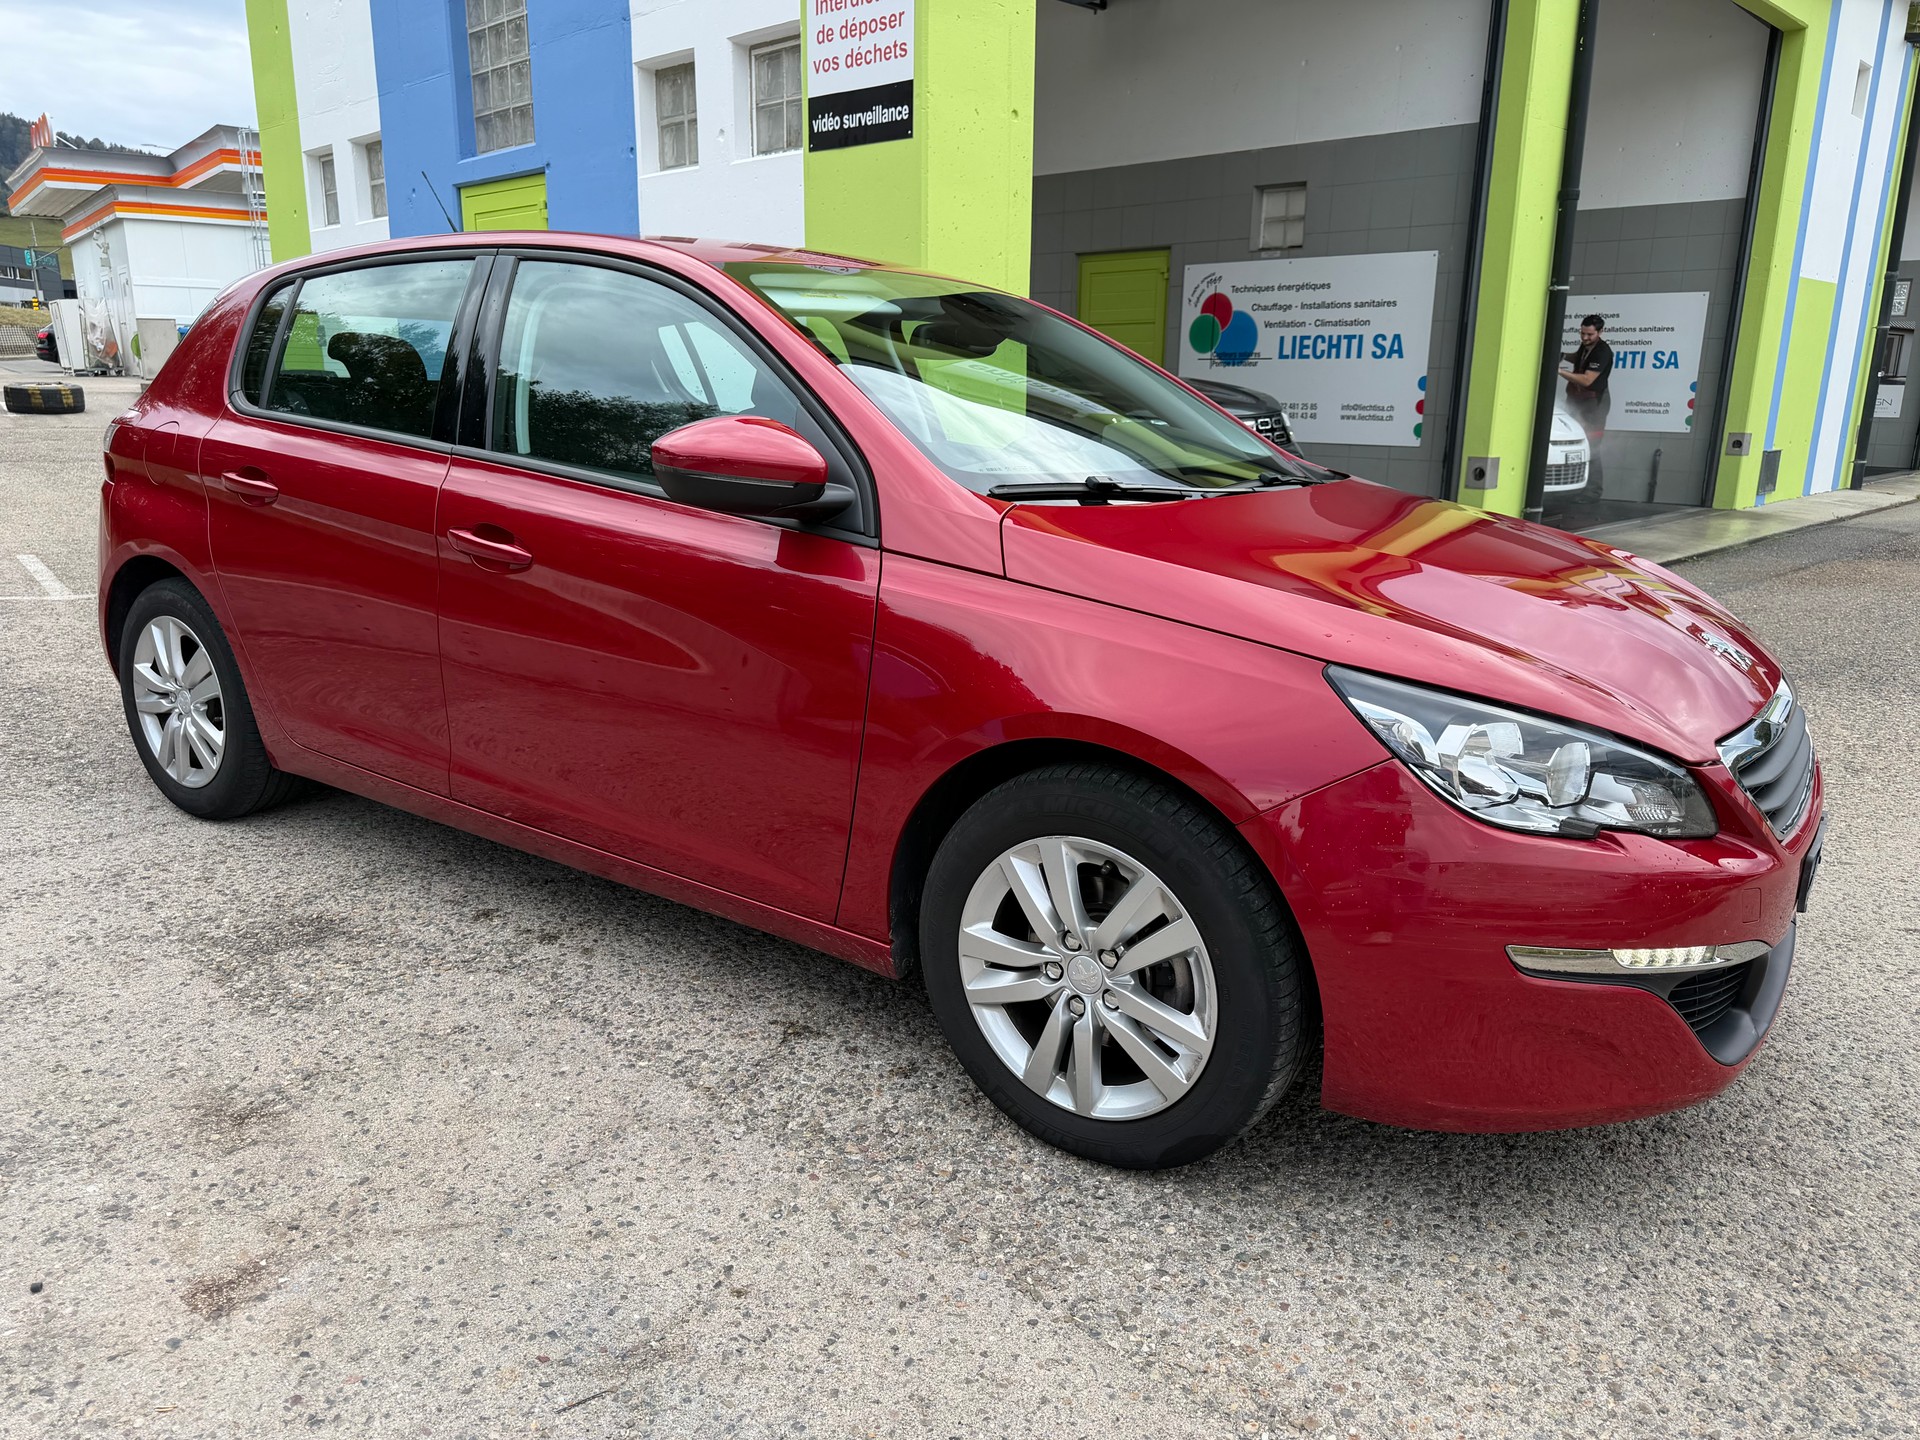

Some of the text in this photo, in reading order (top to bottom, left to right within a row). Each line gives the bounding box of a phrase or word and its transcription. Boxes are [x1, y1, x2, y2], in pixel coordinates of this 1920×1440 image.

[816, 10, 905, 45] de déposer
[813, 40, 908, 74] vos déchets
[812, 104, 910, 133] vidéo surveillance
[1231, 282, 1331, 294] Techniques énergétiques
[1251, 303, 1293, 312] Chauffage
[1300, 300, 1351, 310] Installations
[1354, 299, 1397, 308] sanitaires
[1264, 320, 1306, 328] Ventilation
[1314, 318, 1370, 327] Climatisation
[1277, 333, 1404, 360] LIECHTI SA
[1652, 350, 1679, 369] SA
[1341, 403, 1394, 412] info@liechtisa.ch
[1340, 413, 1394, 421] www.liechtisa.ch
